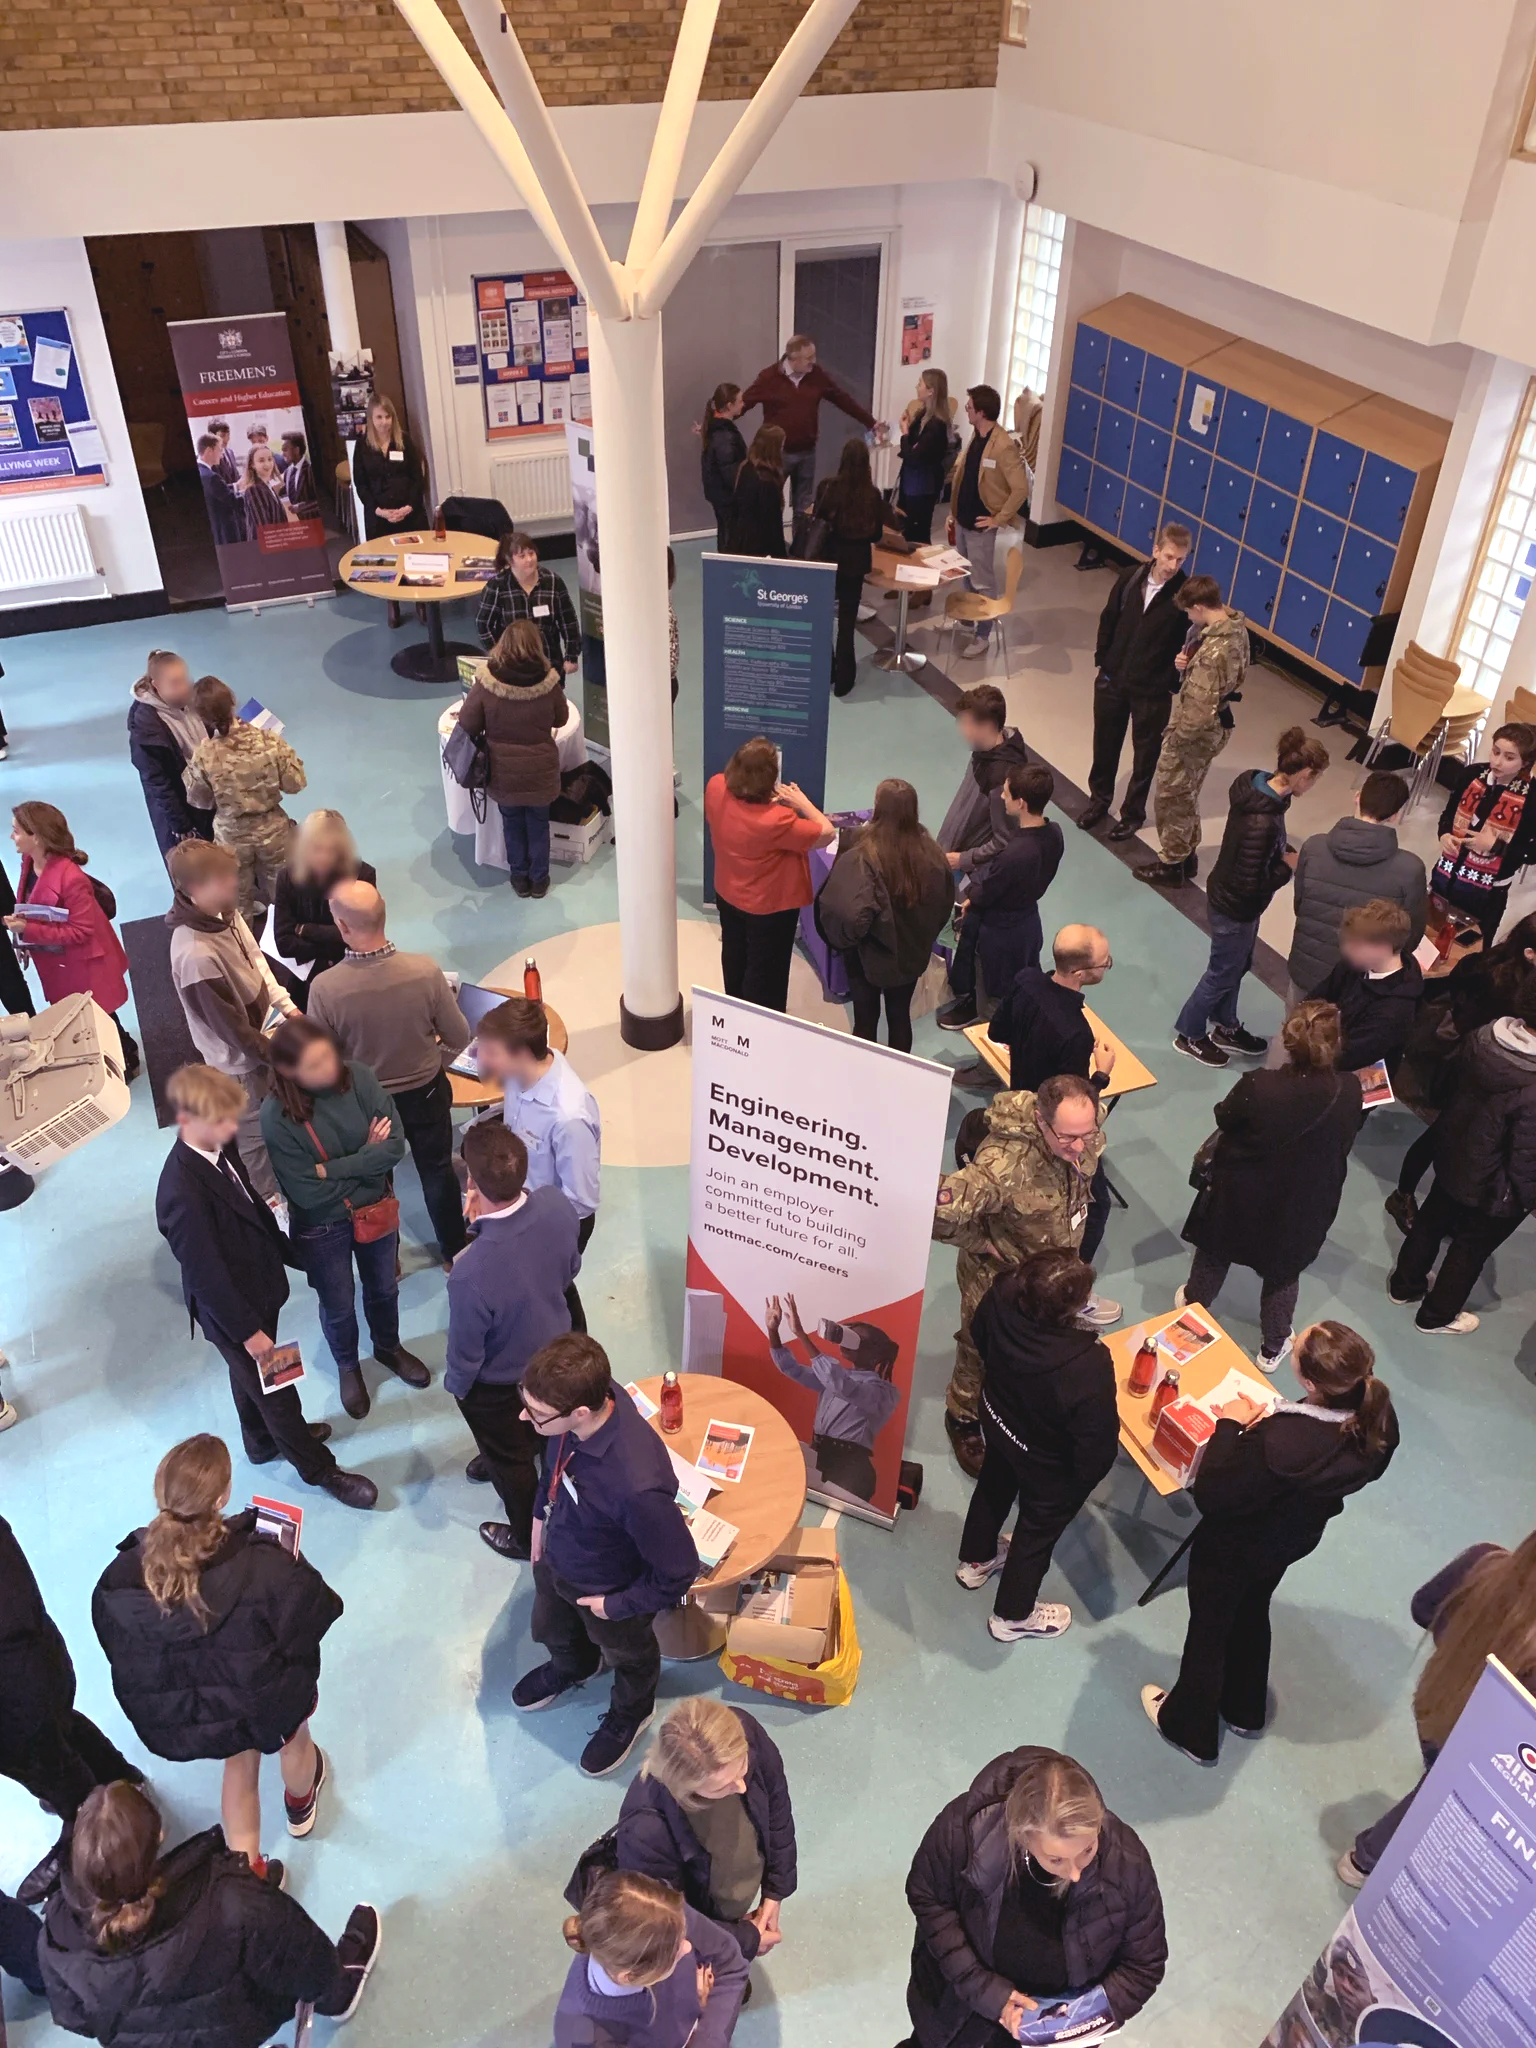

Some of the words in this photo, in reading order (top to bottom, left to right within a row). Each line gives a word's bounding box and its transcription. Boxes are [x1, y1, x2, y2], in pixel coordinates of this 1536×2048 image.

[193, 397, 218, 406] Careers
[234, 393, 257, 403] Higher
[259, 390, 291, 399] Education
[34, 456, 61, 467] WEEK
[757, 589, 767, 600] St
[769, 590, 808, 604] George's
[711, 1035, 728, 1044] MOTT
[711, 1041, 749, 1057] MACDONALD
[710, 1082, 867, 1150] Engineering.
[708, 1134, 879, 1207] Development.
[709, 1108, 879, 1182] Management.
[706, 1167, 736, 1186] Join
[740, 1178, 758, 1192] an
[763, 1185, 834, 1218] employer
[706, 1184, 783, 1216] committed
[787, 1208, 802, 1224] to
[806, 1216, 867, 1248] building
[704, 1201, 713, 1210] a
[717, 1202, 762, 1226] better
[765, 1218, 808, 1243] future
[813, 1234, 834, 1250] for
[838, 1244, 858, 1260] all.
[704, 1222, 849, 1278] mottmac.com/careers
[1492, 1756, 1536, 1808] REGULAR
[1495, 1754, 1534, 1792] AIR
[1450, 1788, 1479, 1824] TECHNICAL
[1479, 1824, 1493, 1840] AND
[1493, 1839, 1534, 1884] ENGINEERING
[1491, 1811, 1536, 1870] FIN
